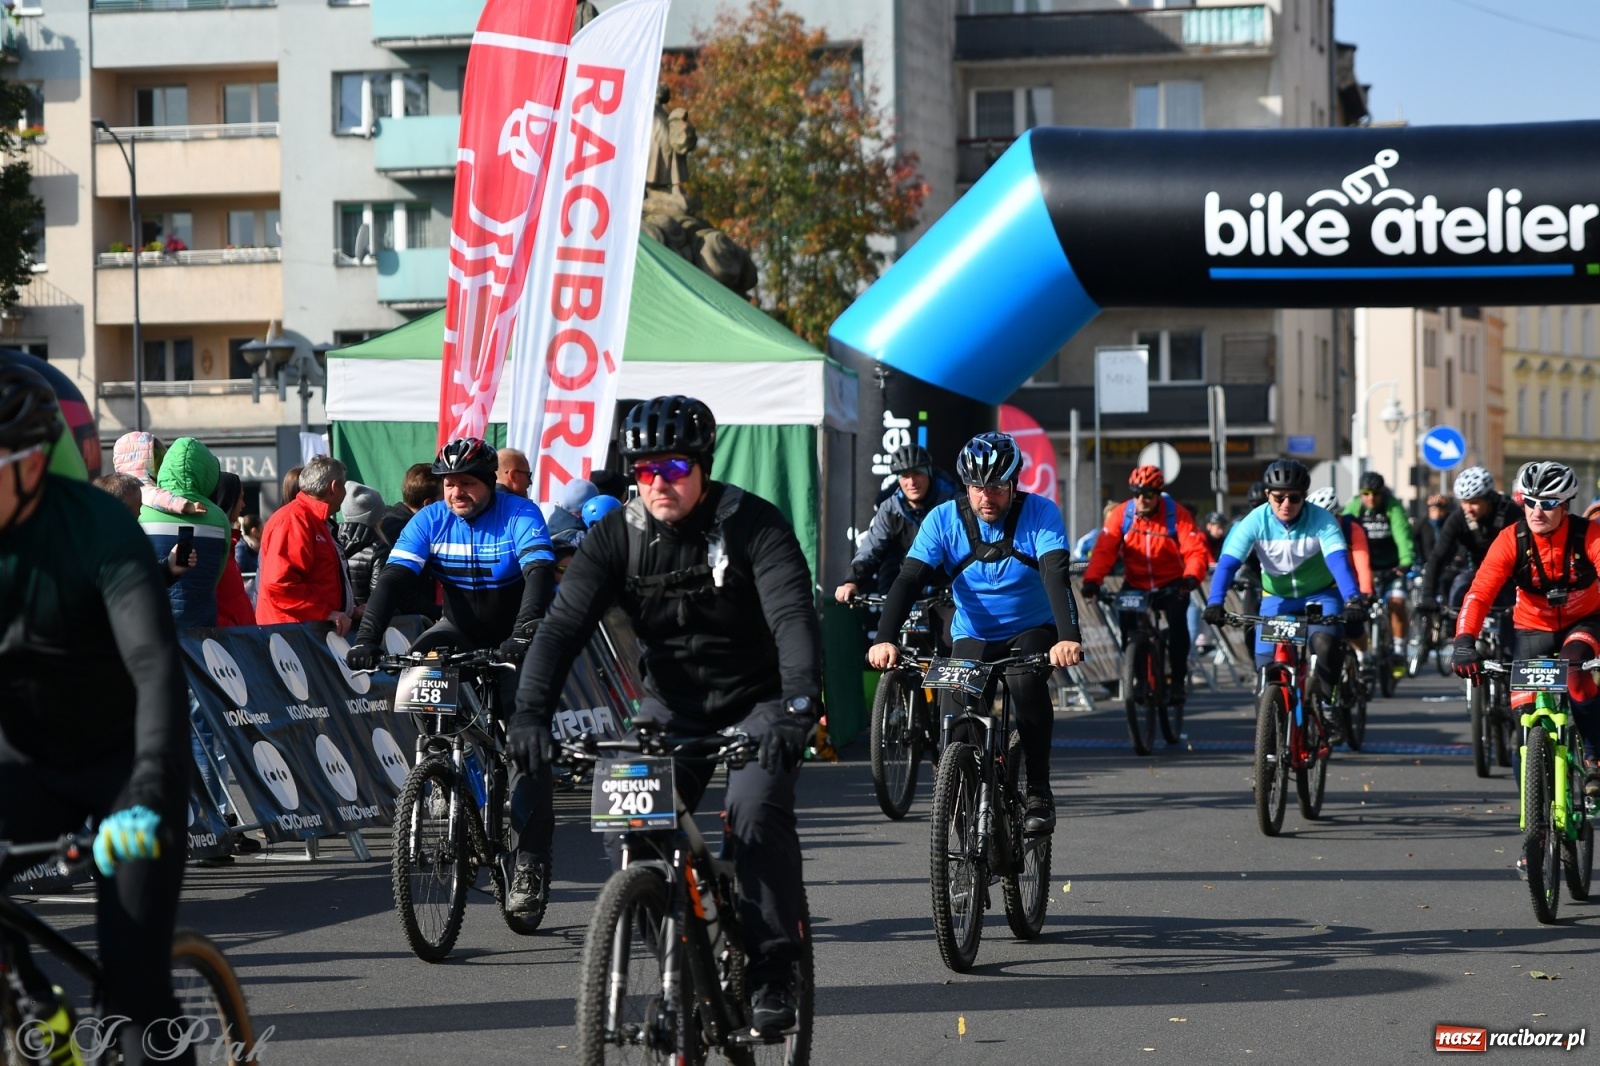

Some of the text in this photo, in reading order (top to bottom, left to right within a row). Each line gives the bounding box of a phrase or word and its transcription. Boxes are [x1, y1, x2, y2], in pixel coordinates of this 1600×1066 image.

[1204, 187, 1600, 256] bike atelier
[538, 63, 626, 504] RACIBÓRZ
[410, 680, 449, 689] PIEKUN
[1526, 674, 1555, 685] 125
[410, 689, 441, 703] 158
[286, 704, 330, 721] KOKOwear
[346, 698, 388, 714] KOKOwear
[223, 710, 271, 727] KOKOwear
[601, 779, 660, 793] OPIEKUN
[608, 792, 653, 815] 240
[337, 804, 381, 821] KOKOwear
[276, 813, 322, 831] KOKOwear
